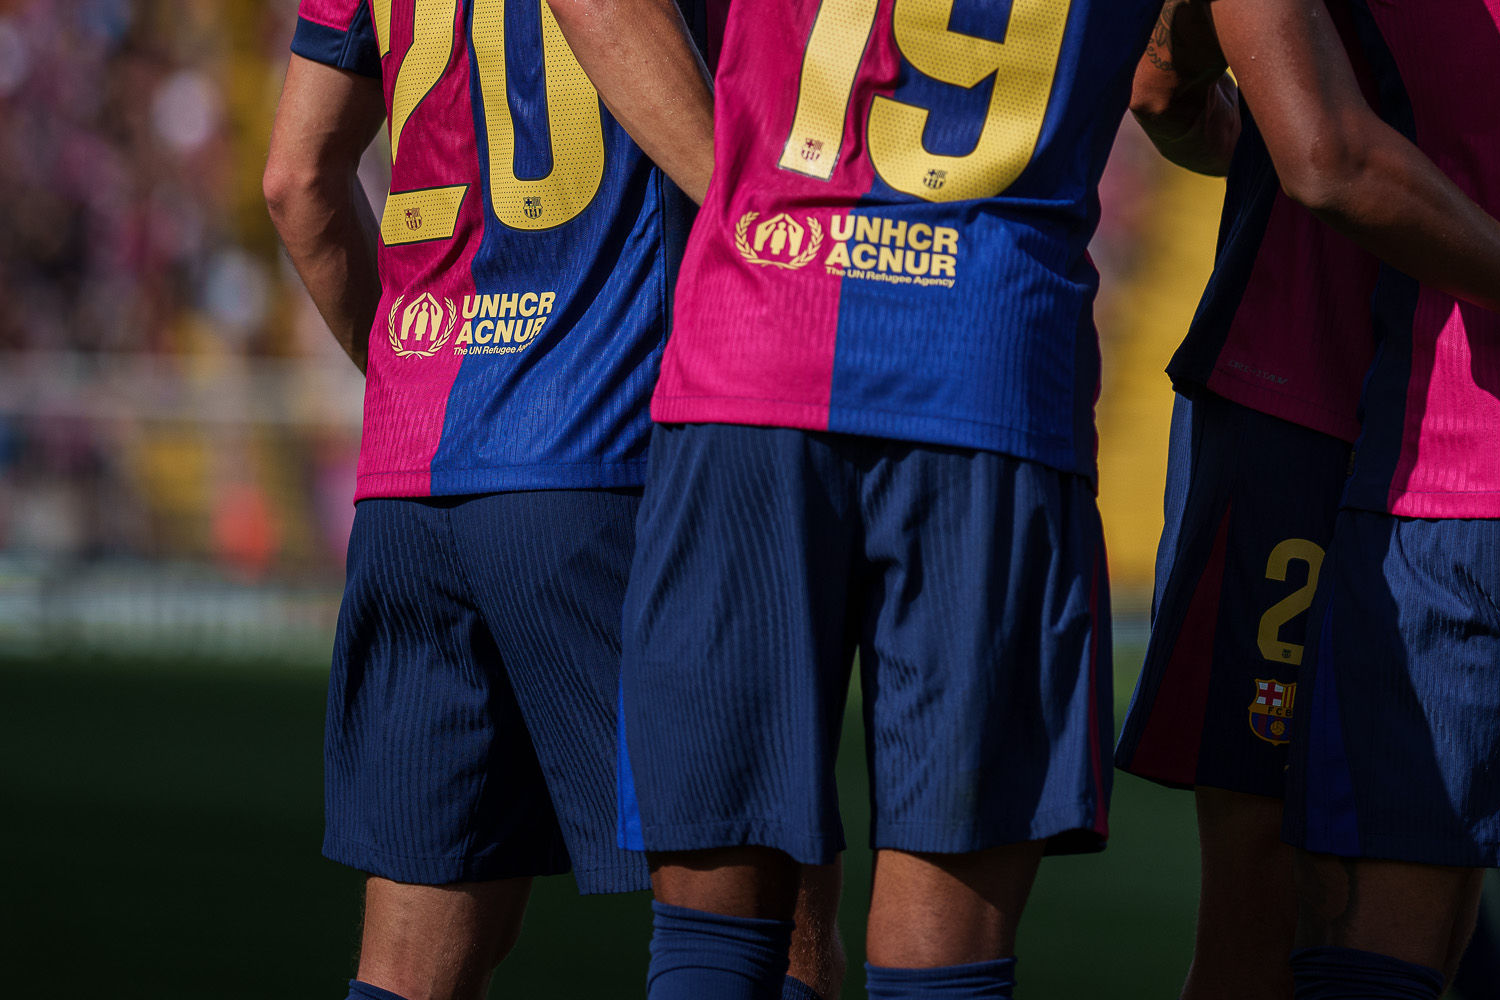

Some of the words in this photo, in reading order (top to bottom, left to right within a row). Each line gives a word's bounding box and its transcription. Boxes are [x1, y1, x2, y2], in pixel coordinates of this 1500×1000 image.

[830, 215, 959, 255] UNHCR
[825, 242, 957, 277] ACNUR
[825, 266, 846, 276] The
[847, 269, 865, 280] UN
[866, 271, 912, 284] Refugee
[913, 275, 956, 288] Agency
[461, 291, 556, 319] UNHCR
[455, 316, 547, 345] ACNUR
[453, 347, 468, 355] The
[468, 346, 482, 355] UN
[482, 346, 516, 355] Refugee
[1257, 538, 1324, 666] 2
